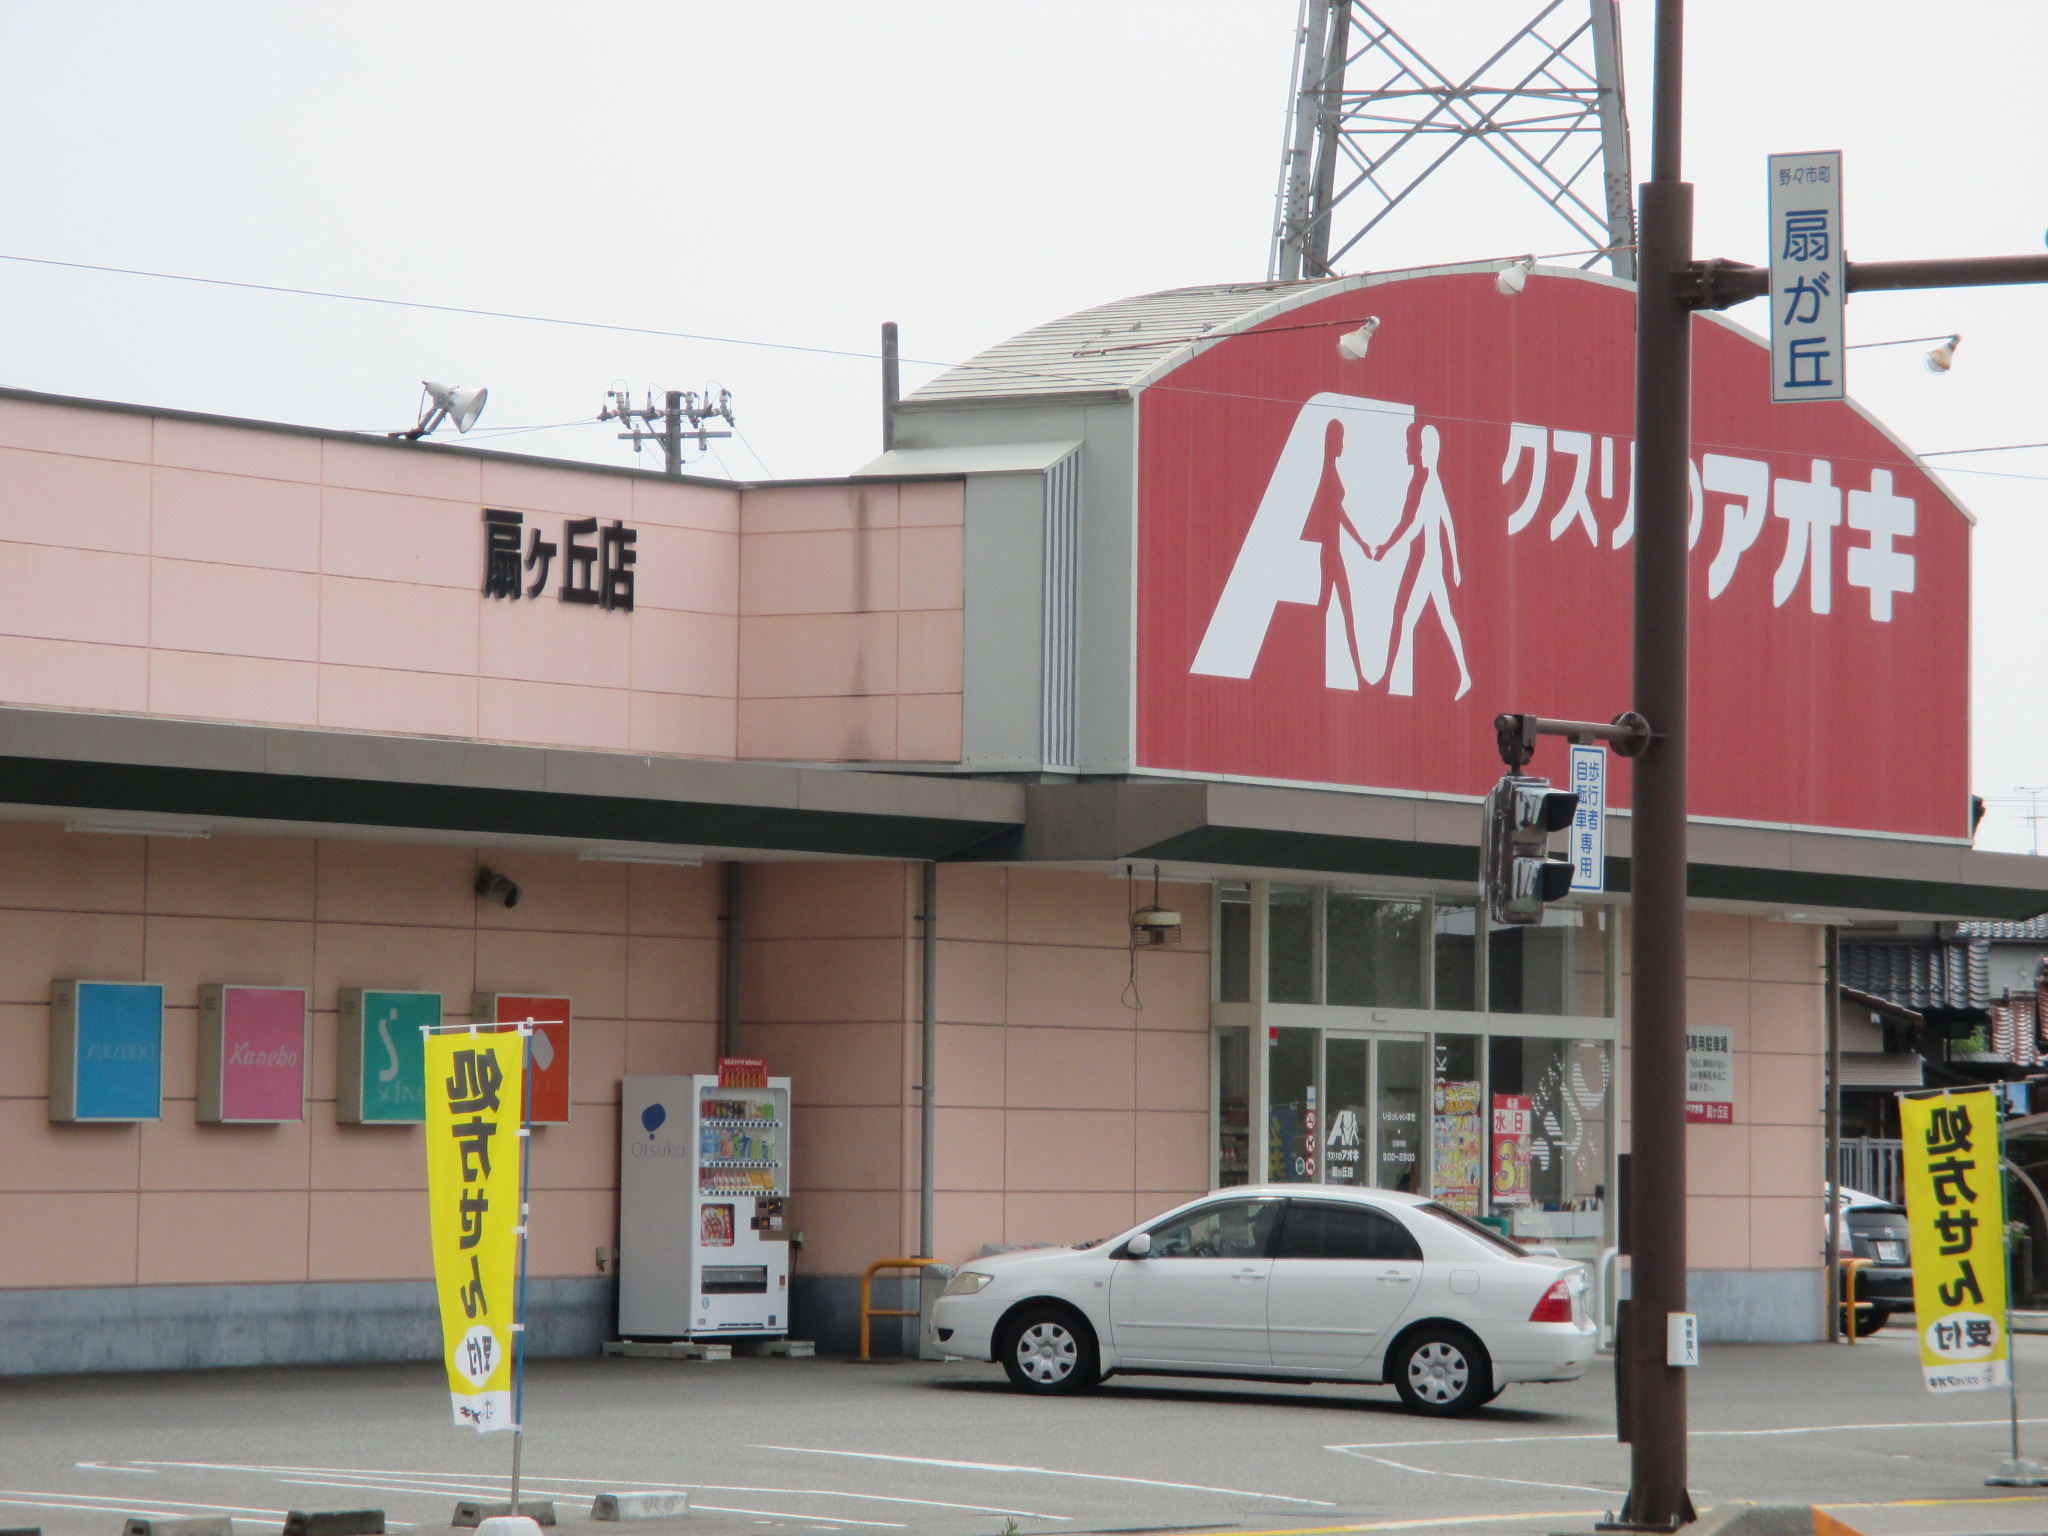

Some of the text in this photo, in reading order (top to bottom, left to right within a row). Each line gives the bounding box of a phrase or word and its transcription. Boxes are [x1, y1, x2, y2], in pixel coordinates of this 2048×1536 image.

[1779, 165, 1831, 186] 野々市町
[1782, 209, 1833, 388] 扇が丘
[1502, 422, 1915, 622] クスリアオキ
[1588, 761, 1600, 830] 歩行者
[1580, 833, 1593, 879] 専用
[230, 1043, 297, 1066] Kanebo
[631, 1142, 685, 1159] Otsuka
